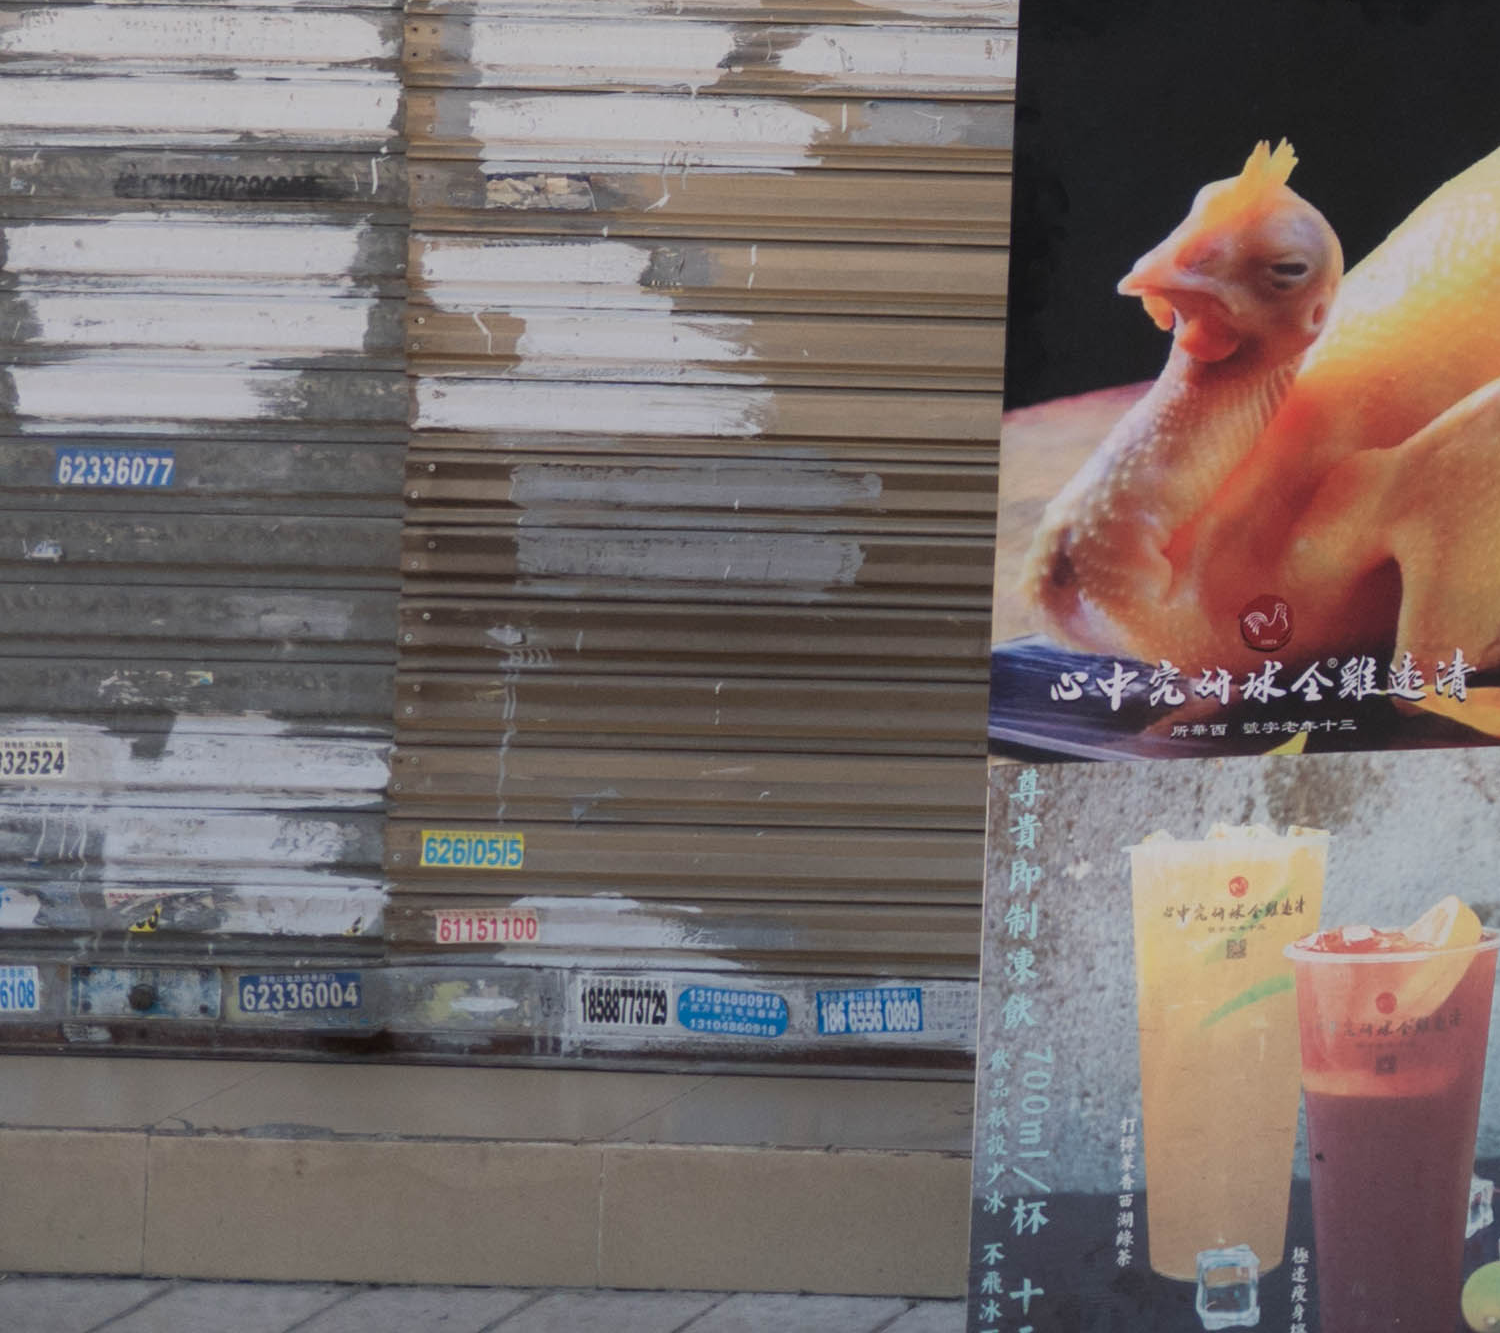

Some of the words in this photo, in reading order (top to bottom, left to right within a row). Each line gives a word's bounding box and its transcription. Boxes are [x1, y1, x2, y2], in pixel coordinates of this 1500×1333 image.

[58, 453, 174, 486] 62336077
[439, 915, 538, 943] 61151100
[242, 985, 358, 1012] 62336004
[580, 988, 668, 1025] 18588773729
[687, 989, 780, 1009] 13104860918
[821, 1005, 847, 1033] 186
